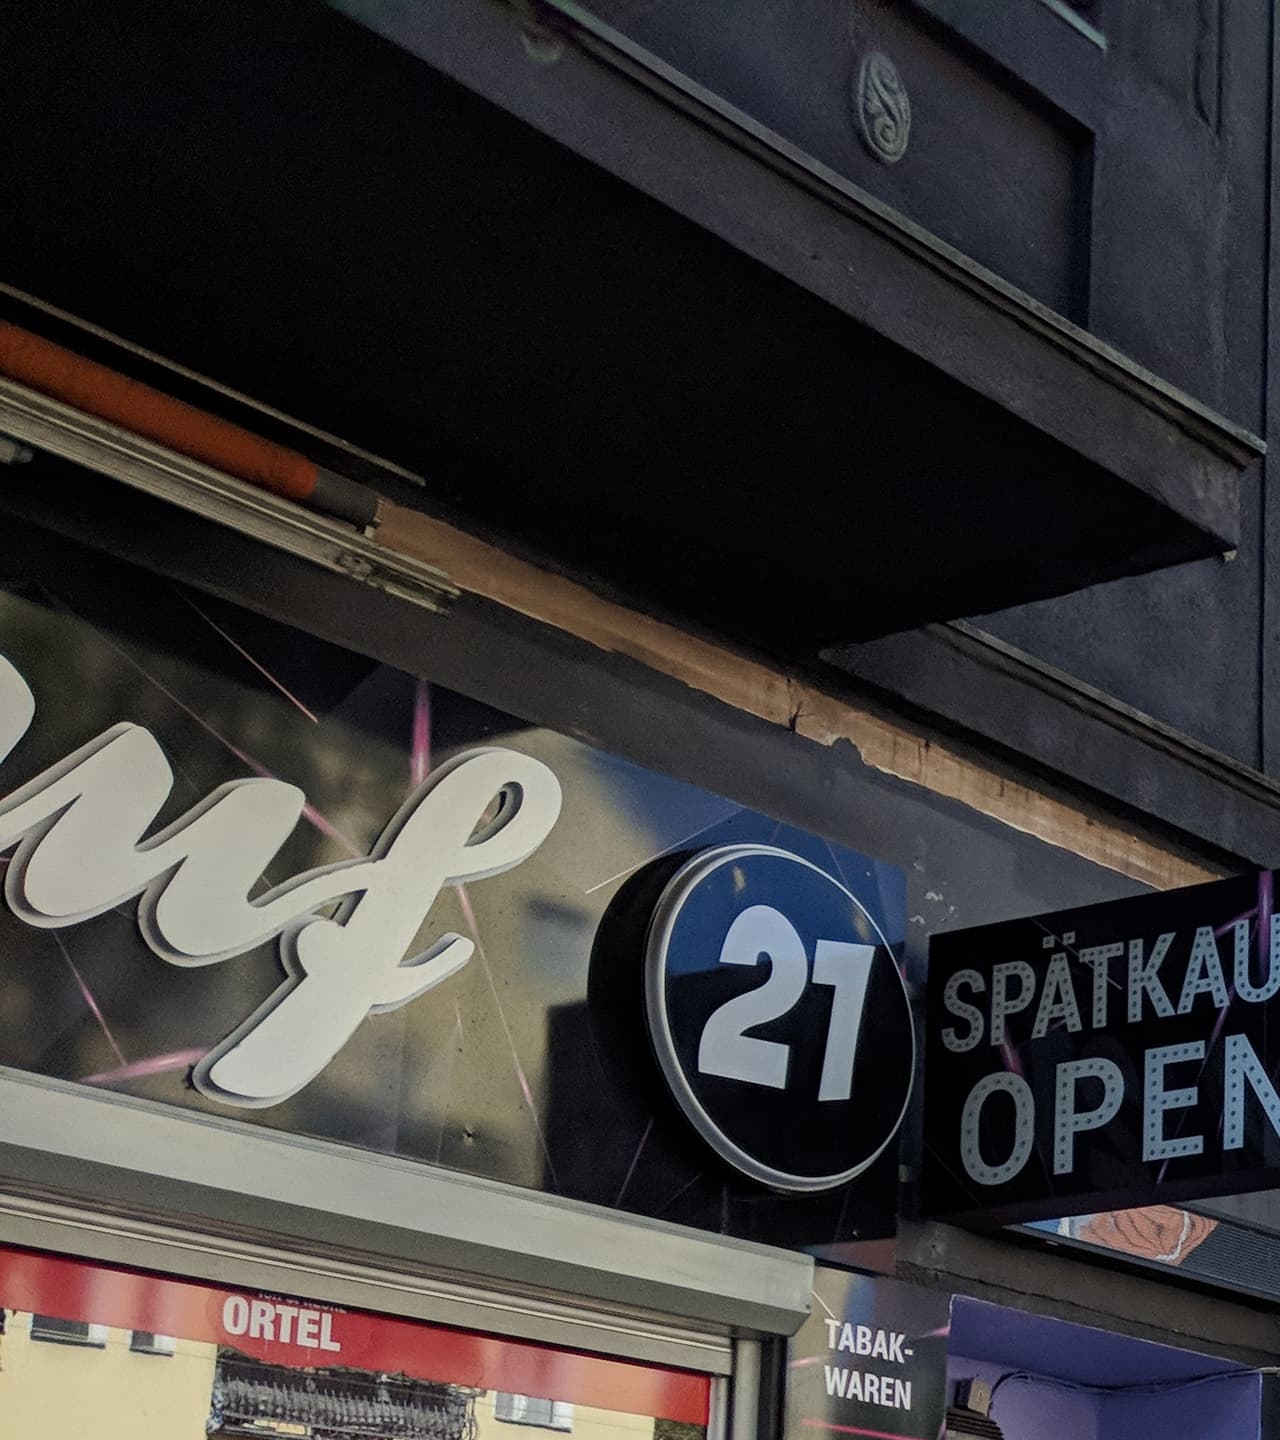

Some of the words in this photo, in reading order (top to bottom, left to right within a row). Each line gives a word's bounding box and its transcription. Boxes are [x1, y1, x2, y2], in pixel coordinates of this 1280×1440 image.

[698, 904, 876, 1101] 21
[223, 1295, 341, 1352] ORTEL
[824, 1318, 913, 1364] TABAK-
[824, 1365, 912, 1411] WAREN
